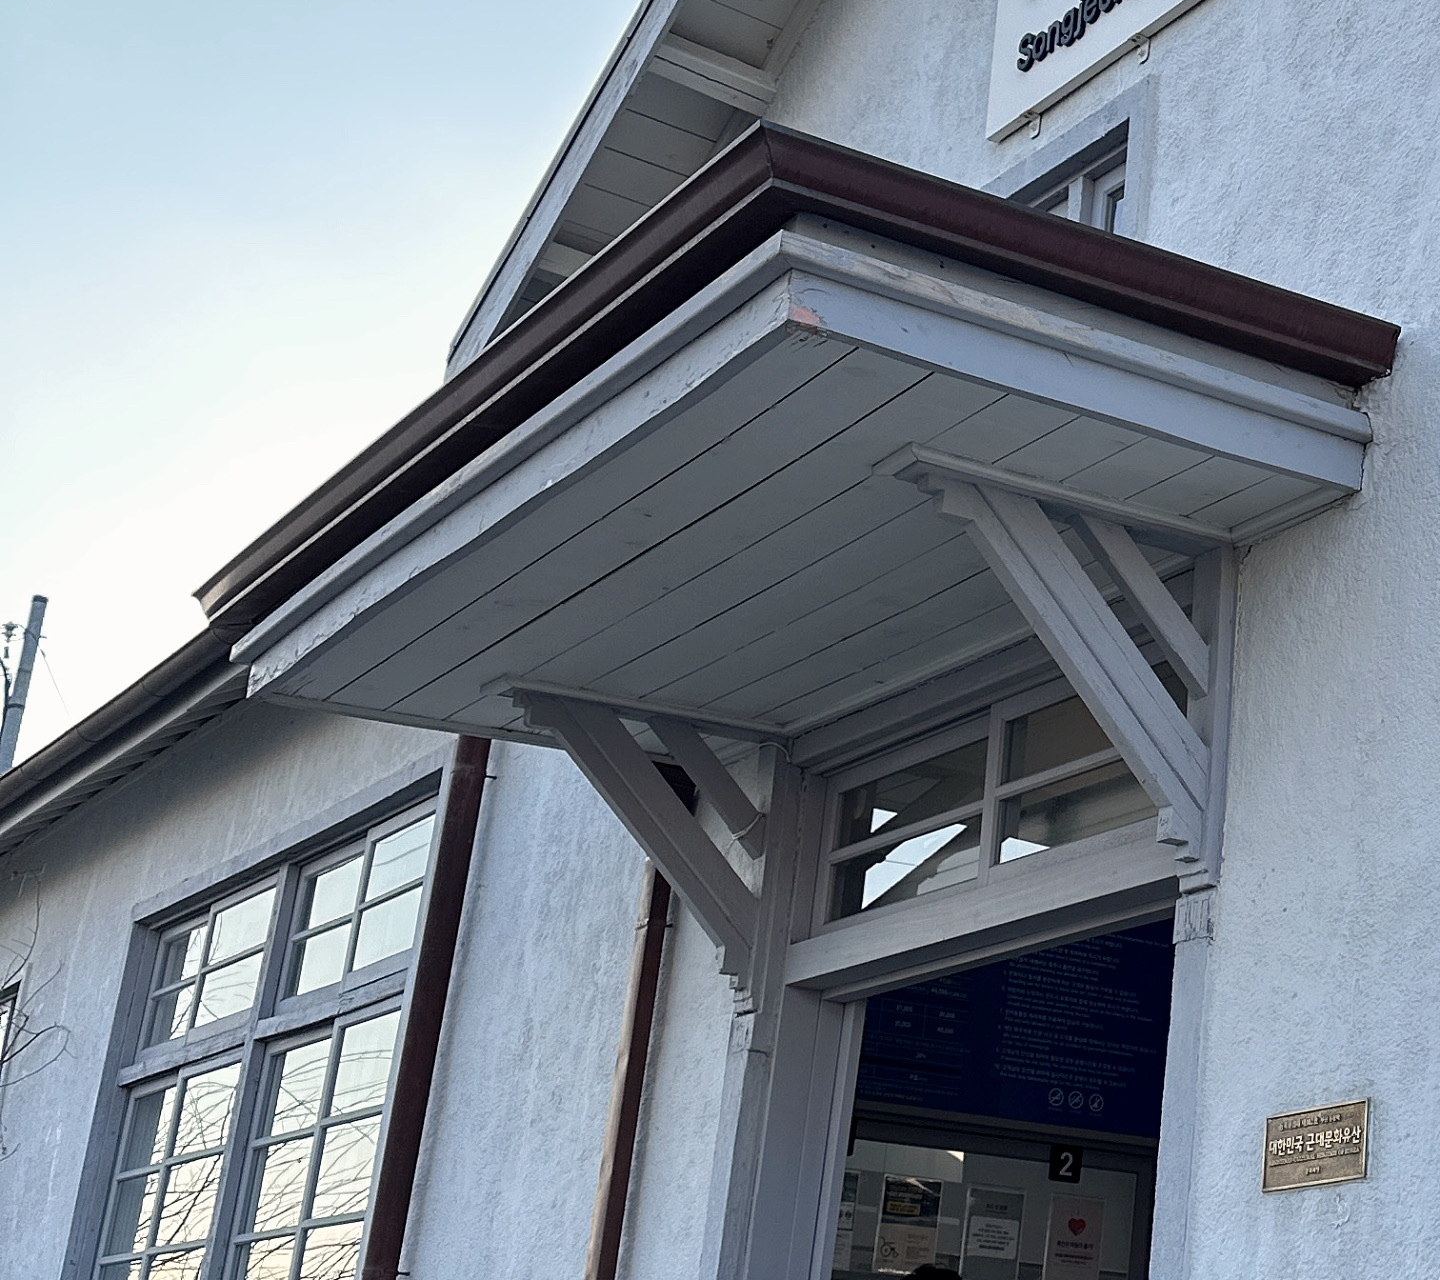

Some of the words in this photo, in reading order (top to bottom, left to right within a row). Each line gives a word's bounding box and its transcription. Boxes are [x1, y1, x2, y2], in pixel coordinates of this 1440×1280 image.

[1268, 1133, 1304, 1156] 대한민국
[1305, 1125, 1362, 1151] 근대문화유산
[1058, 1151, 1074, 1177] 2
